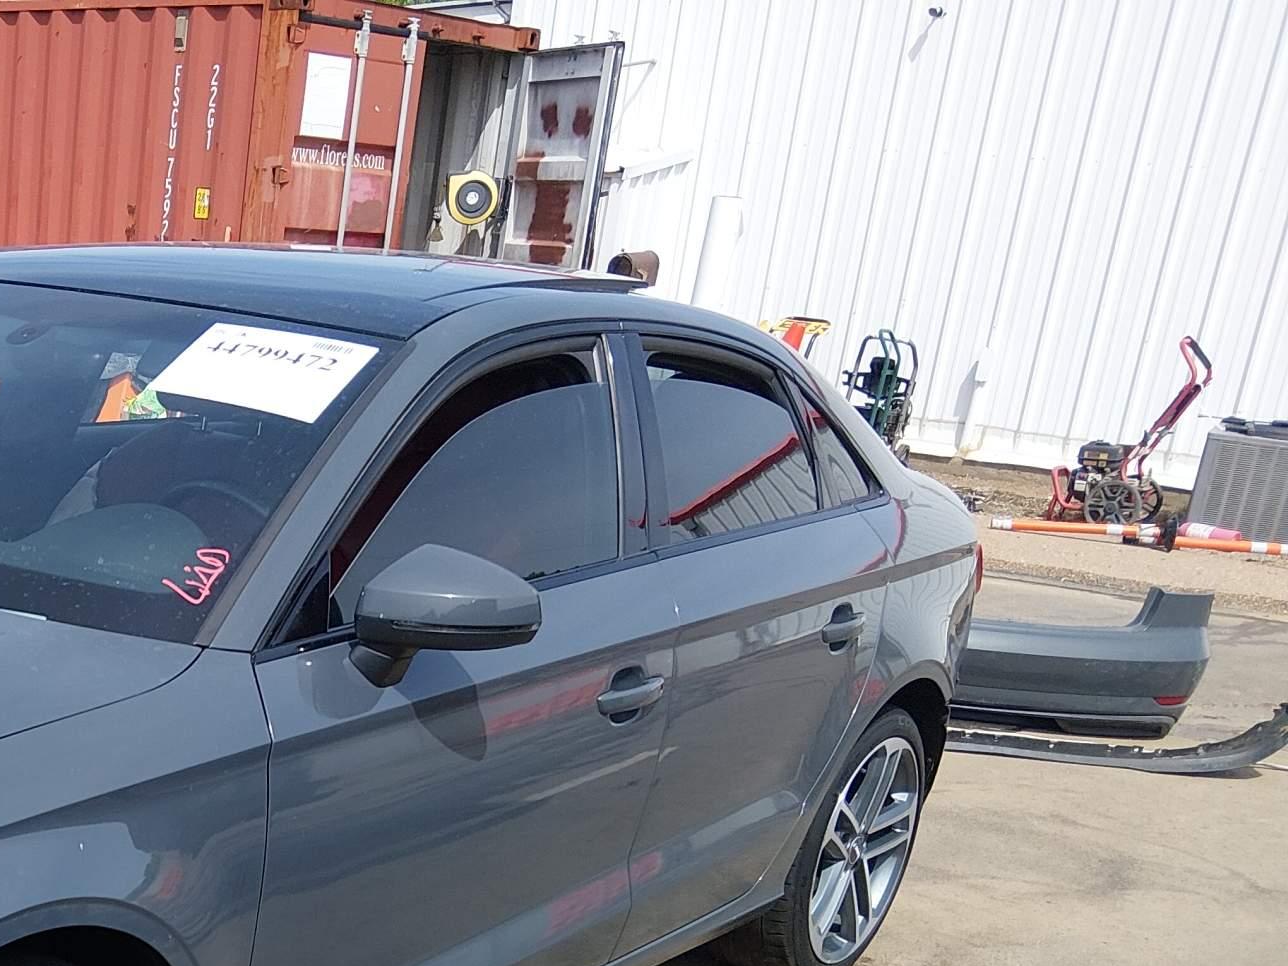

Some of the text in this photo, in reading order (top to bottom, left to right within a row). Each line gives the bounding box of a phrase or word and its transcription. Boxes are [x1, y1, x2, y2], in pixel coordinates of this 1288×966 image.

[168, 64, 183, 150] FSCU
[205, 63, 221, 151] 22G1
[292, 143, 385, 170] www.flores.com
[207, 340, 339, 372] 44799472
